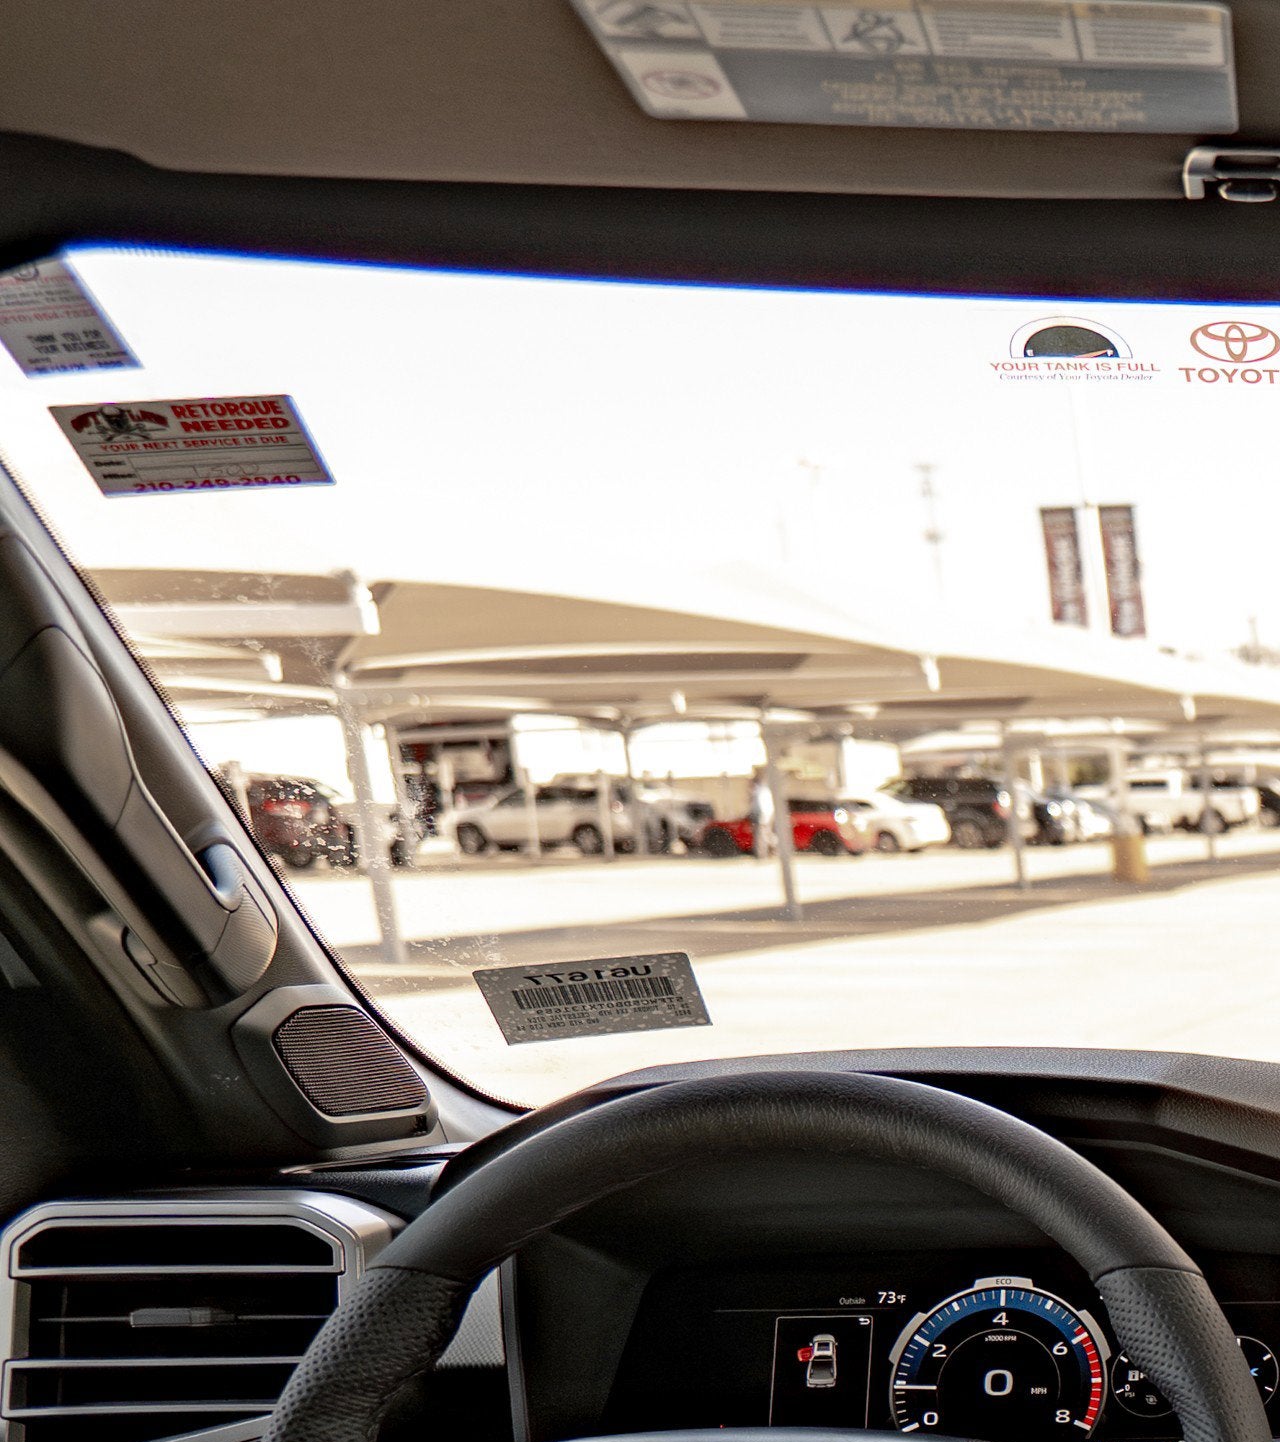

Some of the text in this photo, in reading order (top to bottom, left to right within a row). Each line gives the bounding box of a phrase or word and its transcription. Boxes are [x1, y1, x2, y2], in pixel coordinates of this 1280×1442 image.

[990, 362, 1162, 373] YOUR TANK IS FULL
[169, 400, 284, 419] RETORQUE
[179, 416, 292, 433] NEEDED
[100, 443, 138, 454] YOUR
[143, 441, 179, 451] NEXT
[183, 438, 243, 449] SERVICE
[260, 435, 289, 445] DUE
[995, 1277, 1013, 1287] ECO
[991, 1311, 1010, 1327] 4
[931, 1343, 949, 1358] 2
[1052, 1341, 1069, 1356] 6
[982, 1368, 1014, 1398] 0
[922, 1410, 940, 1426] 0
[1053, 1409, 1071, 1424] 8
